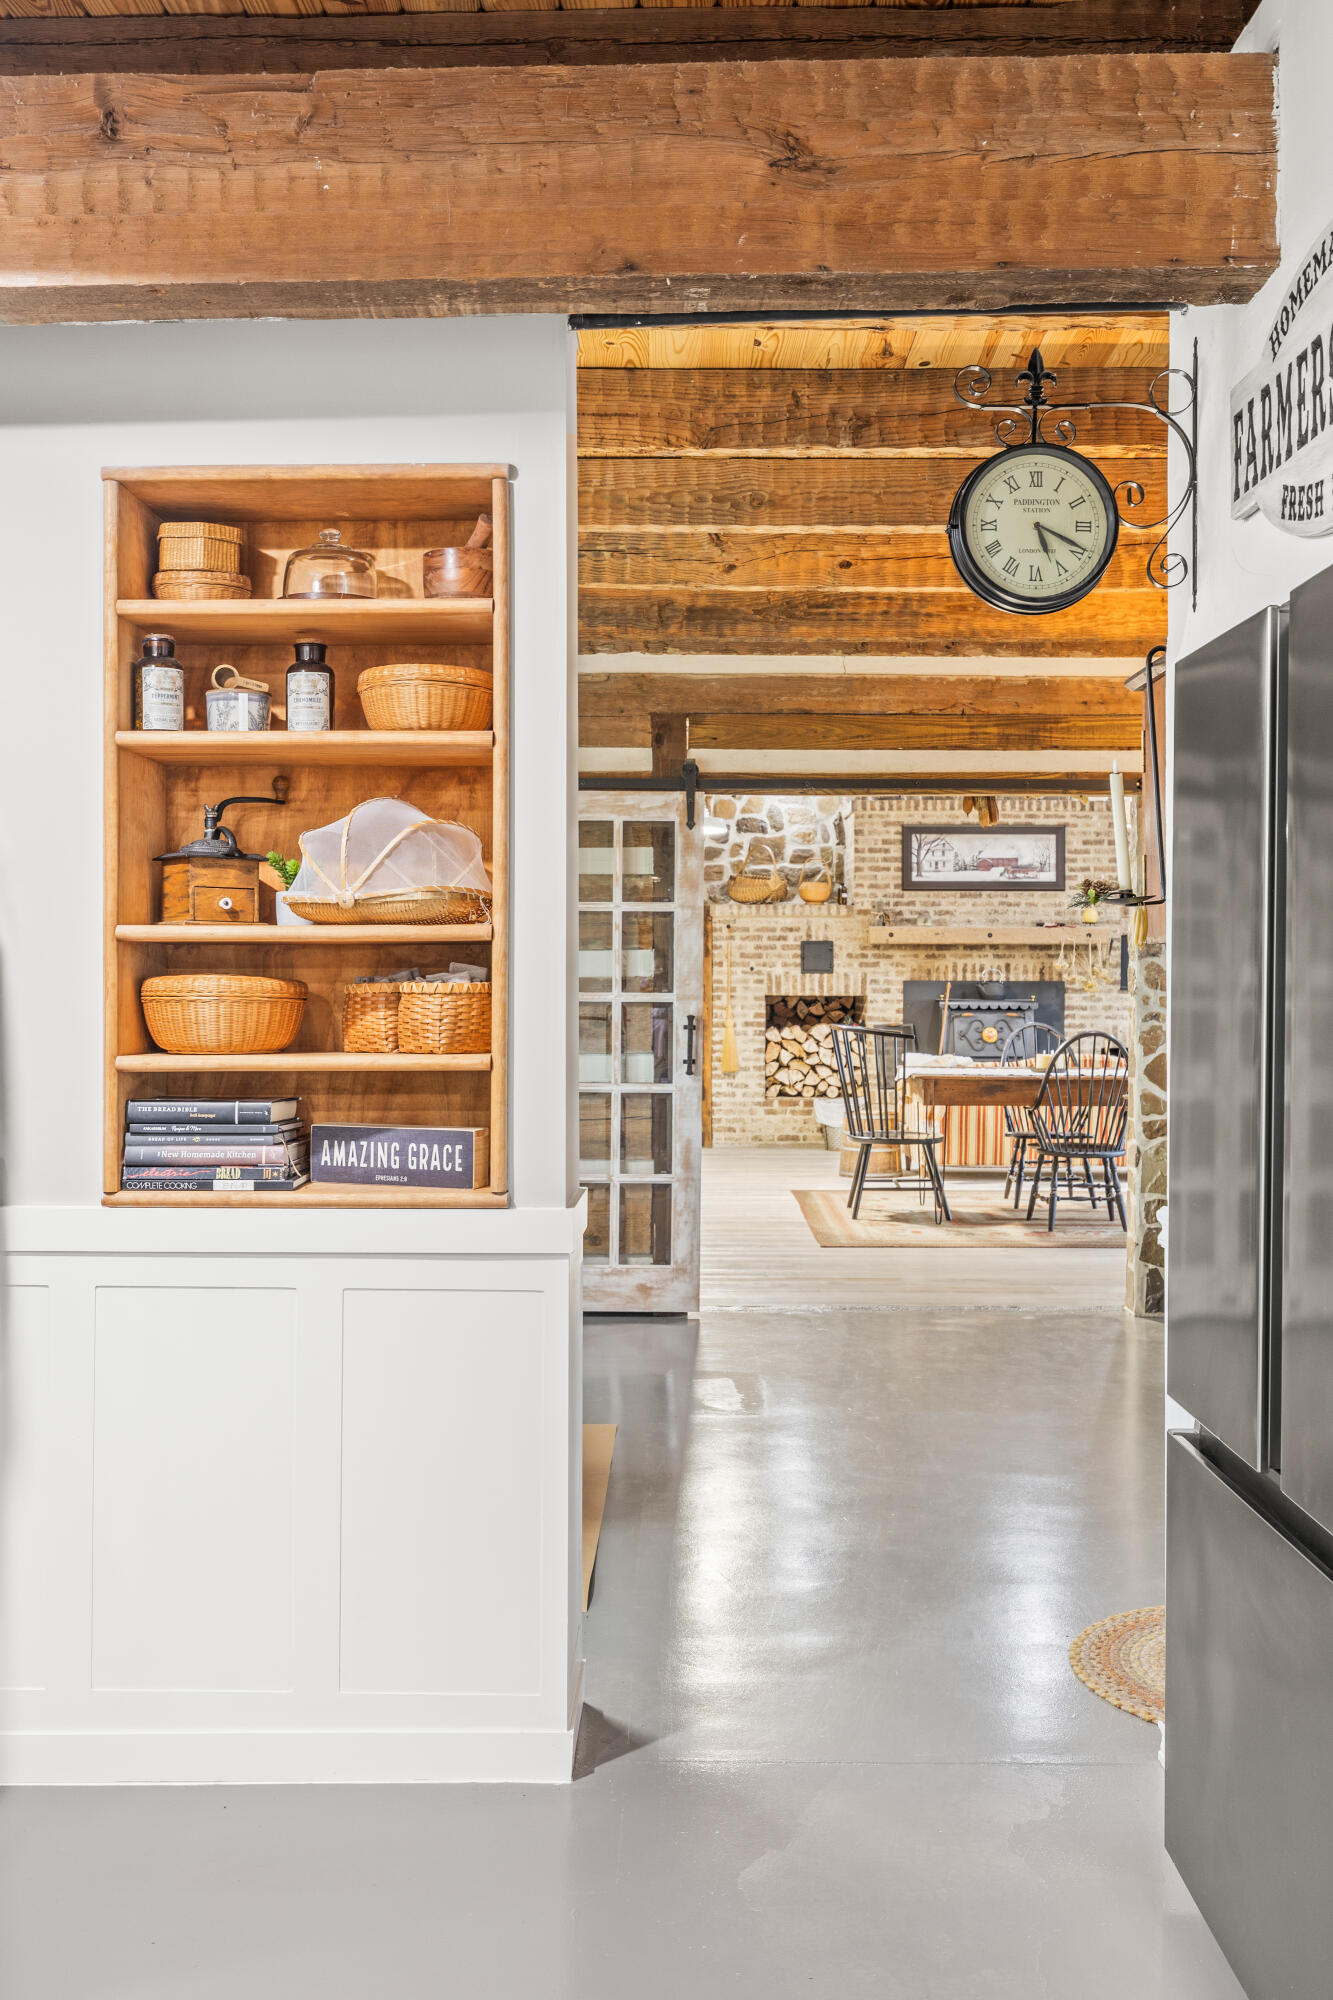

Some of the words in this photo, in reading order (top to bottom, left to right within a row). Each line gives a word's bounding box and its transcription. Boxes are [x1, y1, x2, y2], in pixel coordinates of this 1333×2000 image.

[1029, 471, 1043, 487] XII
[1013, 498, 1060, 506] PADDINGTON
[1281, 479, 1324, 521] FRESH
[161, 1150, 179, 1158] New
[181, 1150, 224, 1158] Homemade
[320, 1139, 400, 1169] AMAZING
[407, 1142, 463, 1172] GRACE
[130, 1167, 206, 1178] electric
[216, 1168, 241, 1179] BREAD
[375, 1174, 399, 1182] EPHESIANS
[126, 1181, 163, 1190] COMPLETE
[163, 1181, 198, 1190] COOKING
